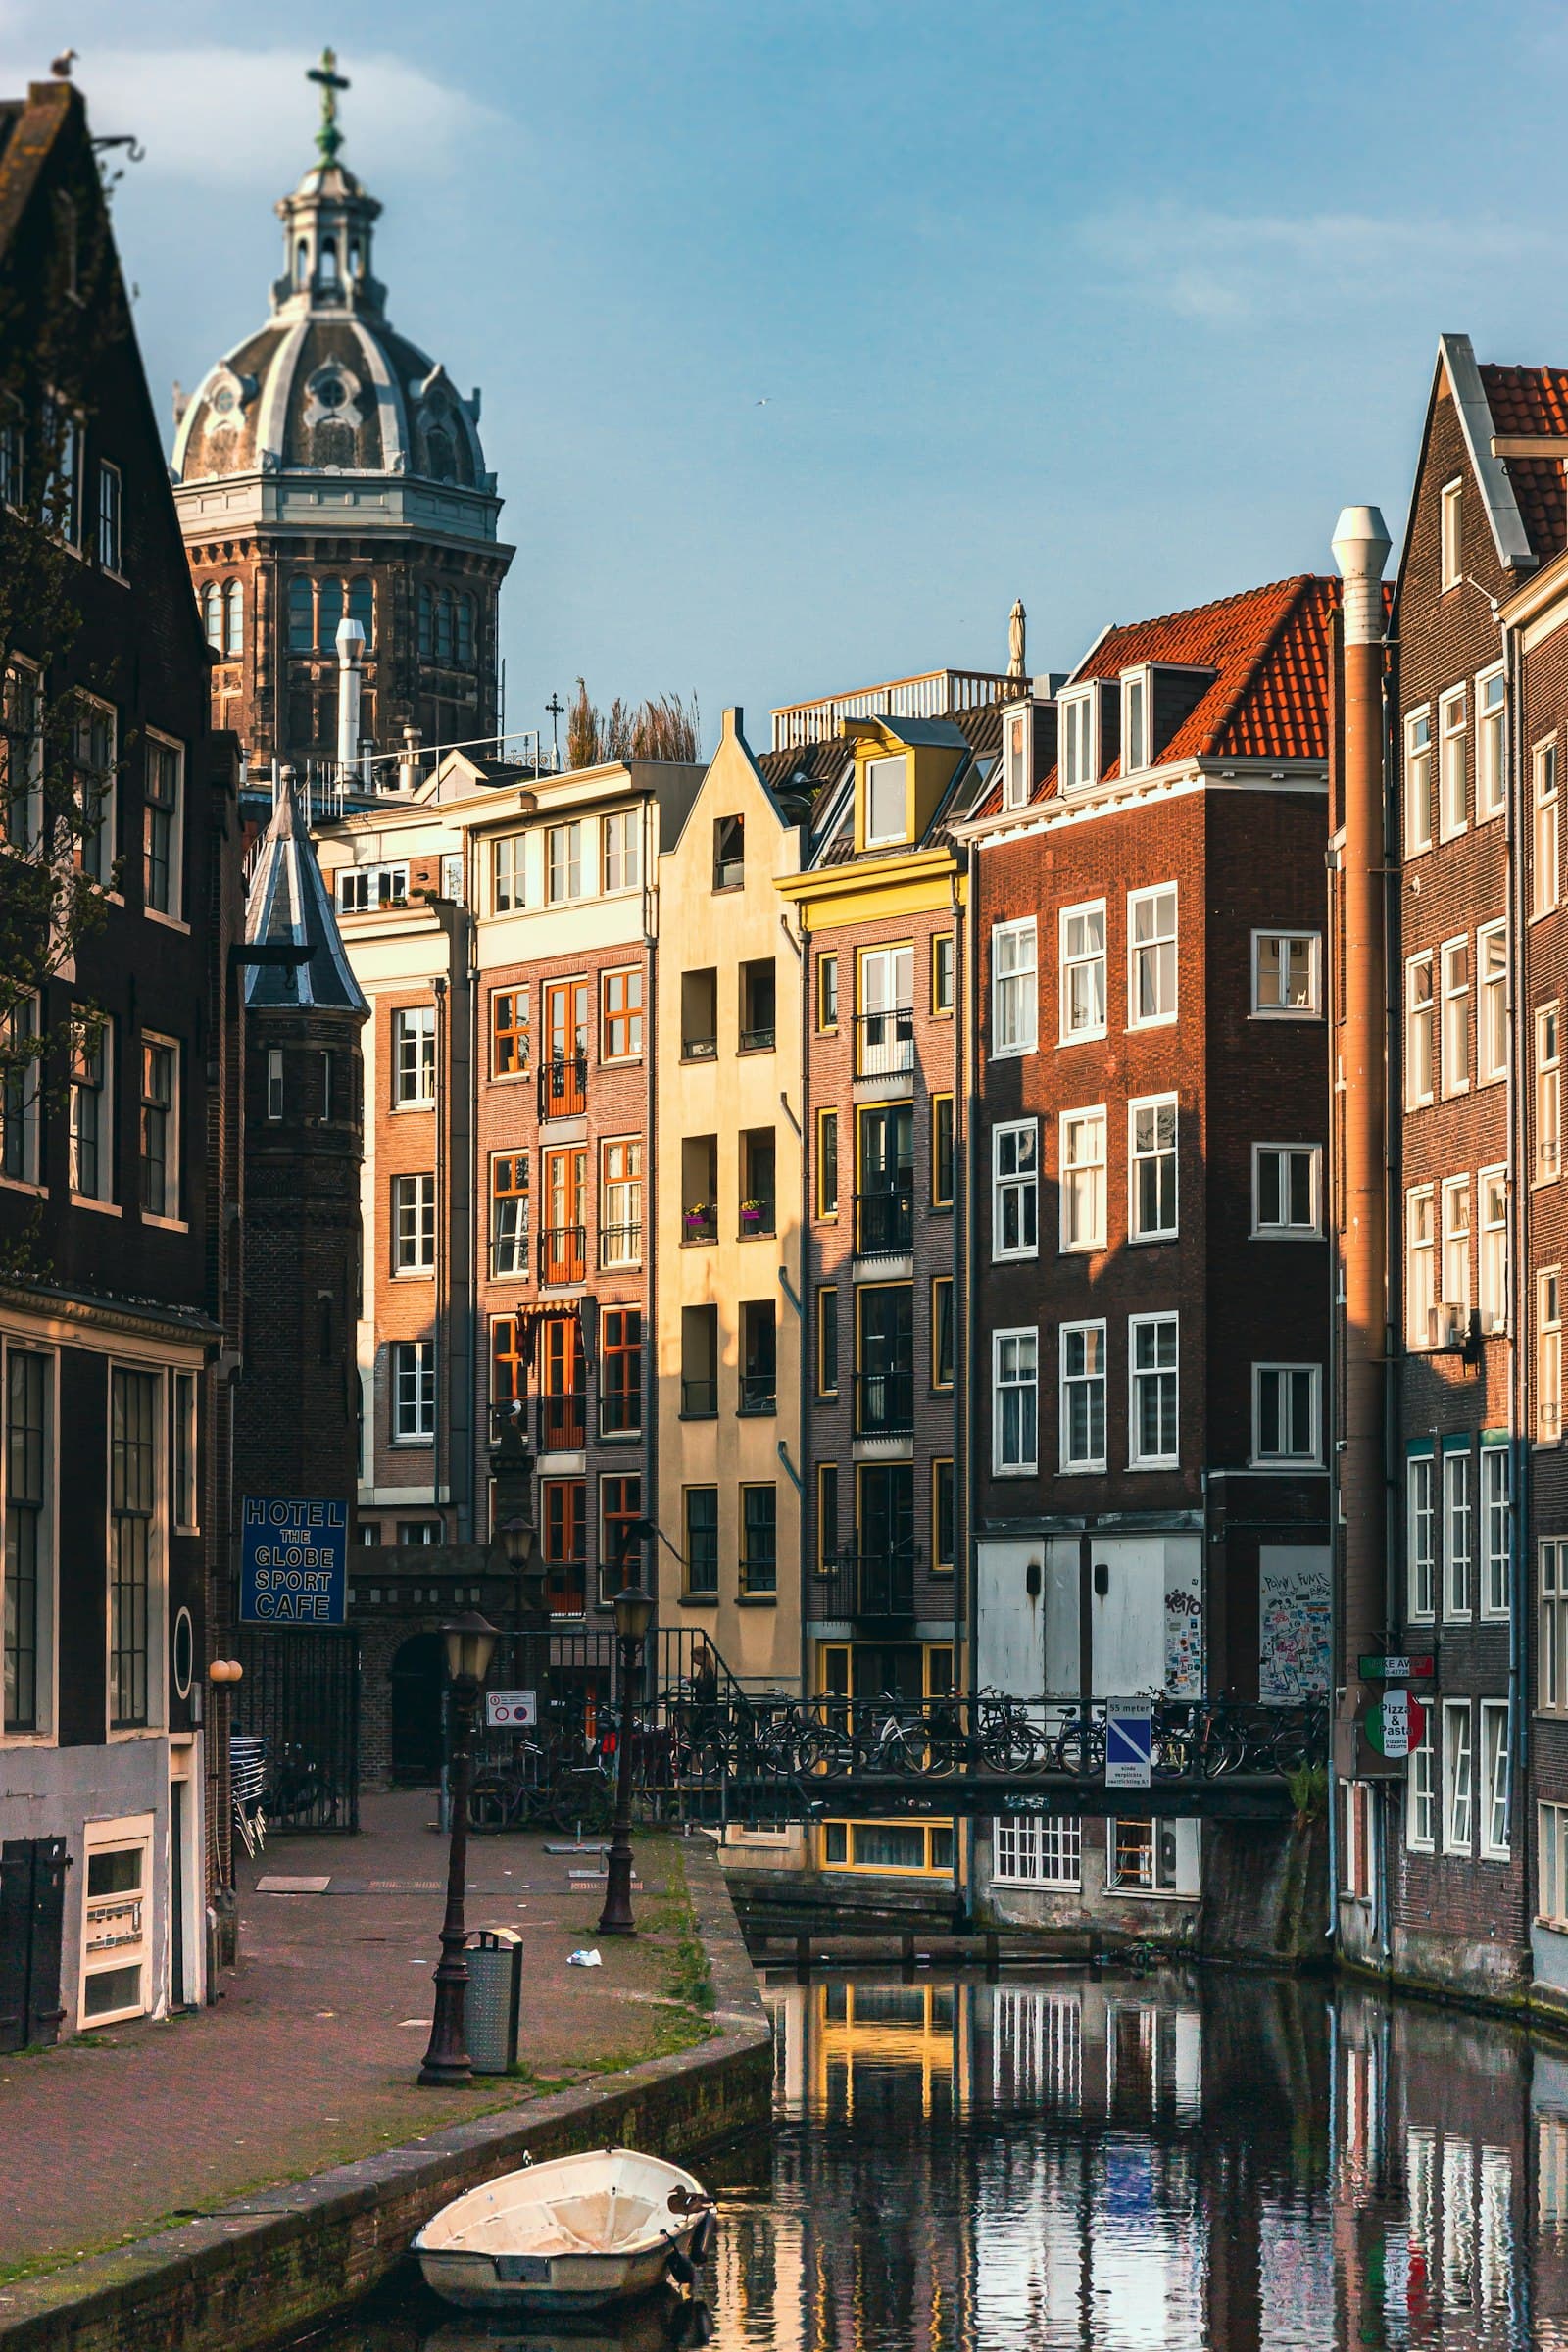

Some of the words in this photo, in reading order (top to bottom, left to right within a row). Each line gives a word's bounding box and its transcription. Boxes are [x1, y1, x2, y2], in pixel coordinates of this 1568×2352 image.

[246, 1499, 344, 1527] HOTEL
[279, 1529, 311, 1544] THE
[255, 1545, 334, 1568] GLOBE
[255, 1569, 333, 1592] SPORT
[255, 1592, 330, 1620] CAFE
[1380, 1703, 1411, 1714] Pizza
[1392, 1715, 1399, 1725] &
[1380, 1725, 1412, 1735] Pasta
